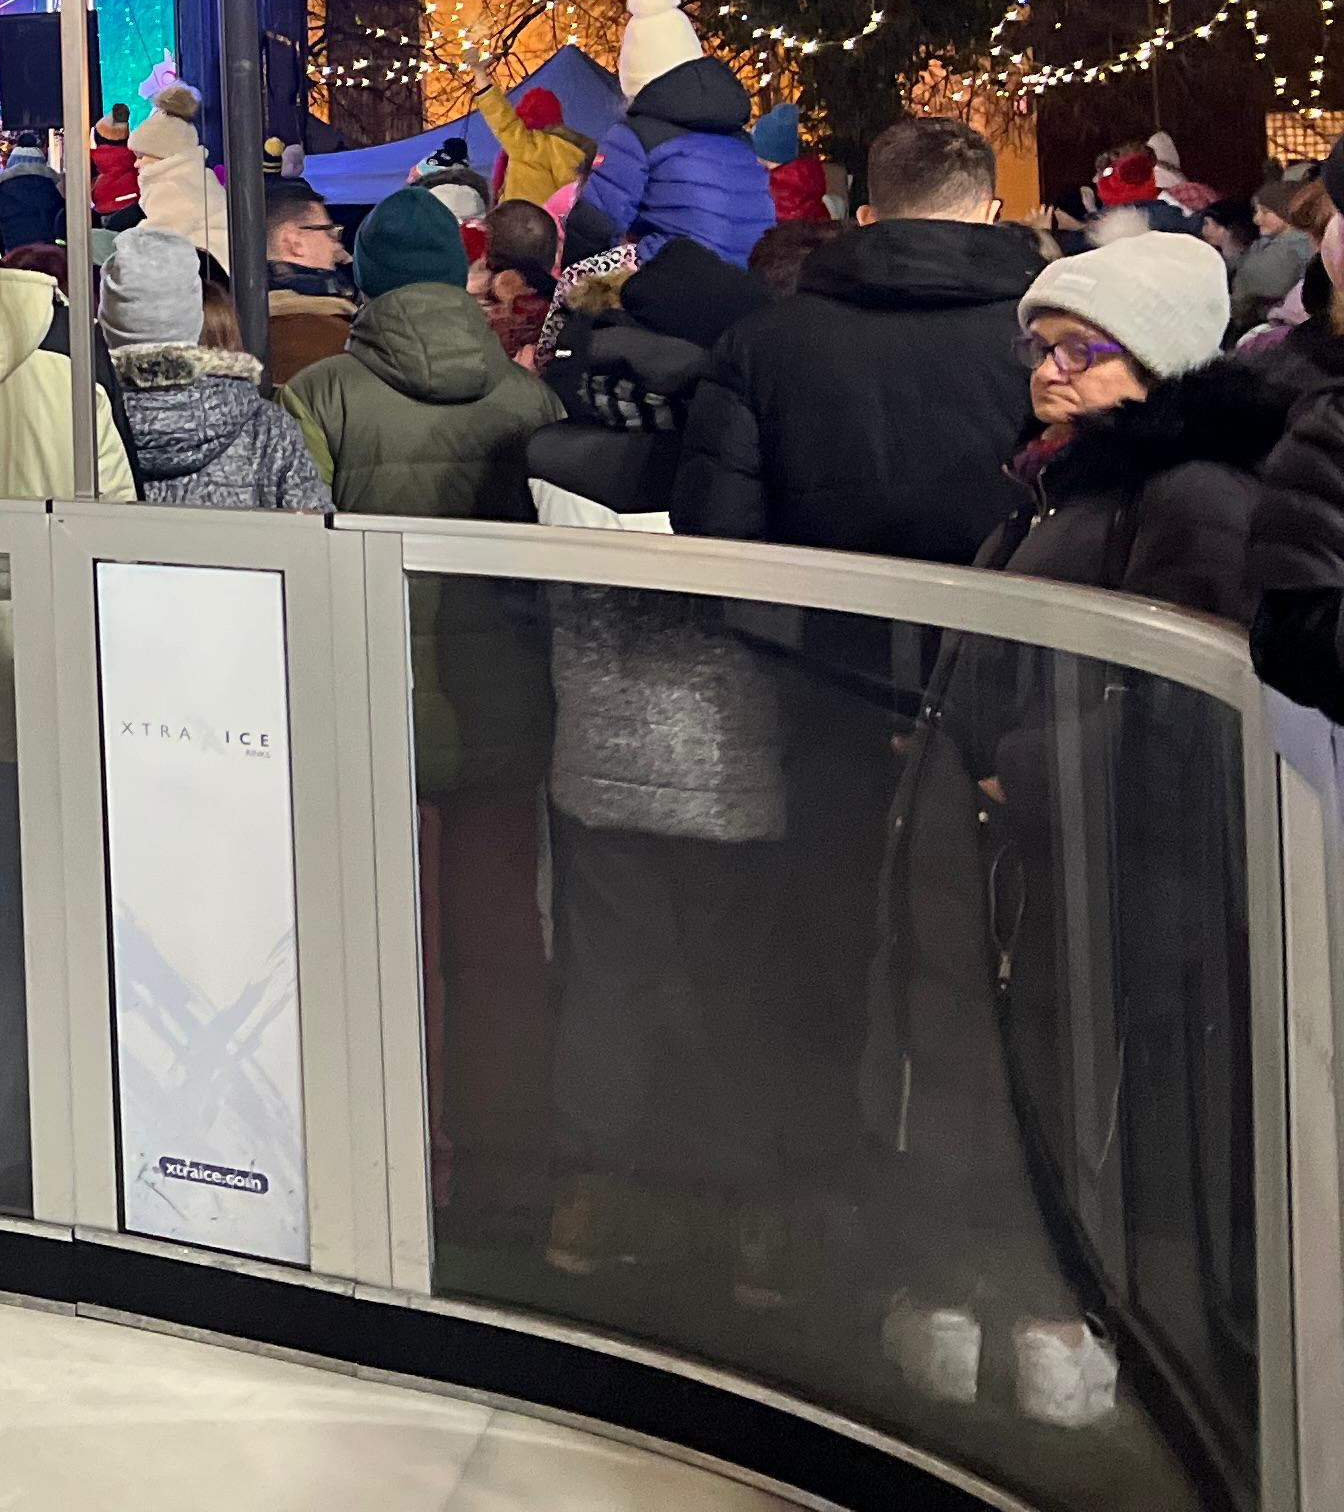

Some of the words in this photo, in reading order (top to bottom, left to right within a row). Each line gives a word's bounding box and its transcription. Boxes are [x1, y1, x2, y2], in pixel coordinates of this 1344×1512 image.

[120, 720, 191, 741] XTRA
[224, 730, 271, 748] ICE
[165, 1161, 262, 1191] xtraice.com
